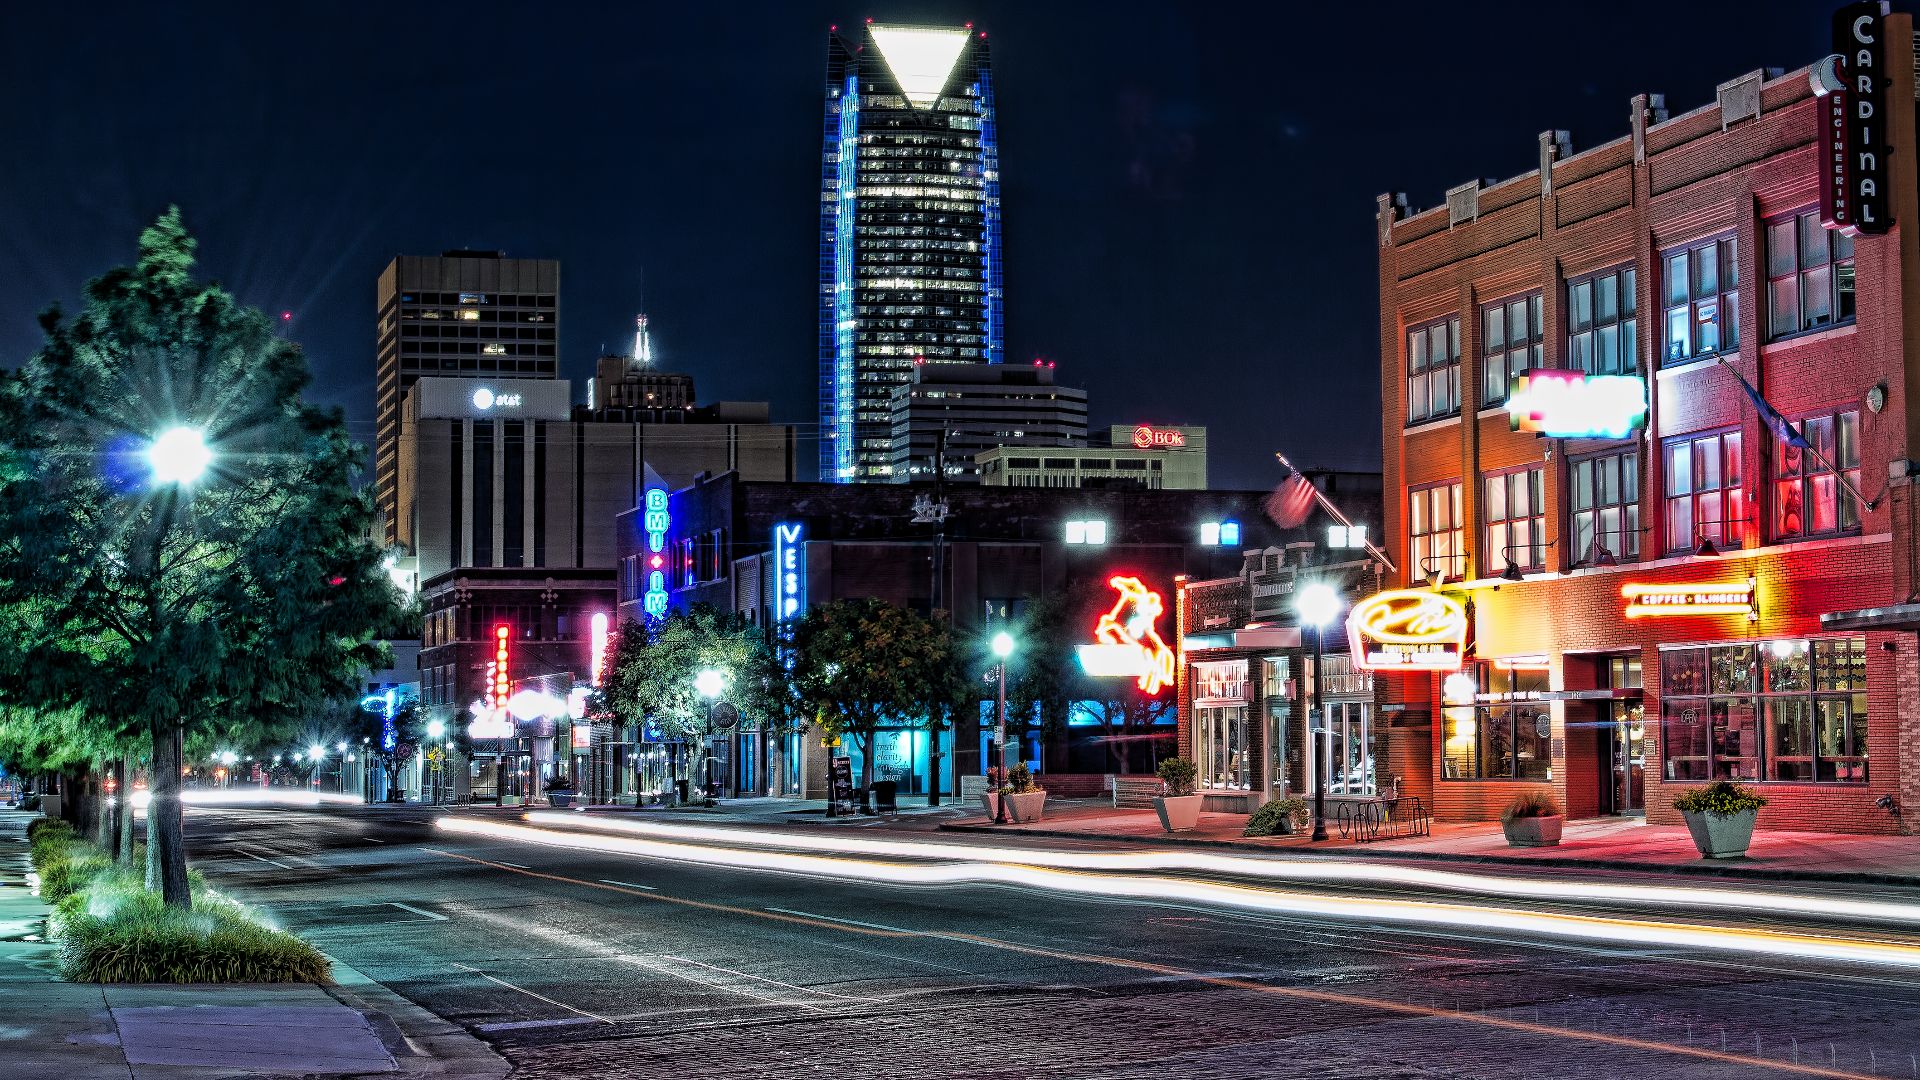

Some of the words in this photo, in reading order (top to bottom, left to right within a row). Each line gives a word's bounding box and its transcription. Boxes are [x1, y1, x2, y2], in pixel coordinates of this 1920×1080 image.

[1833, 95, 1845, 220] ENGINEERING
[648, 491, 666, 550] BMI
[1642, 595, 1686, 605] COFFEE
